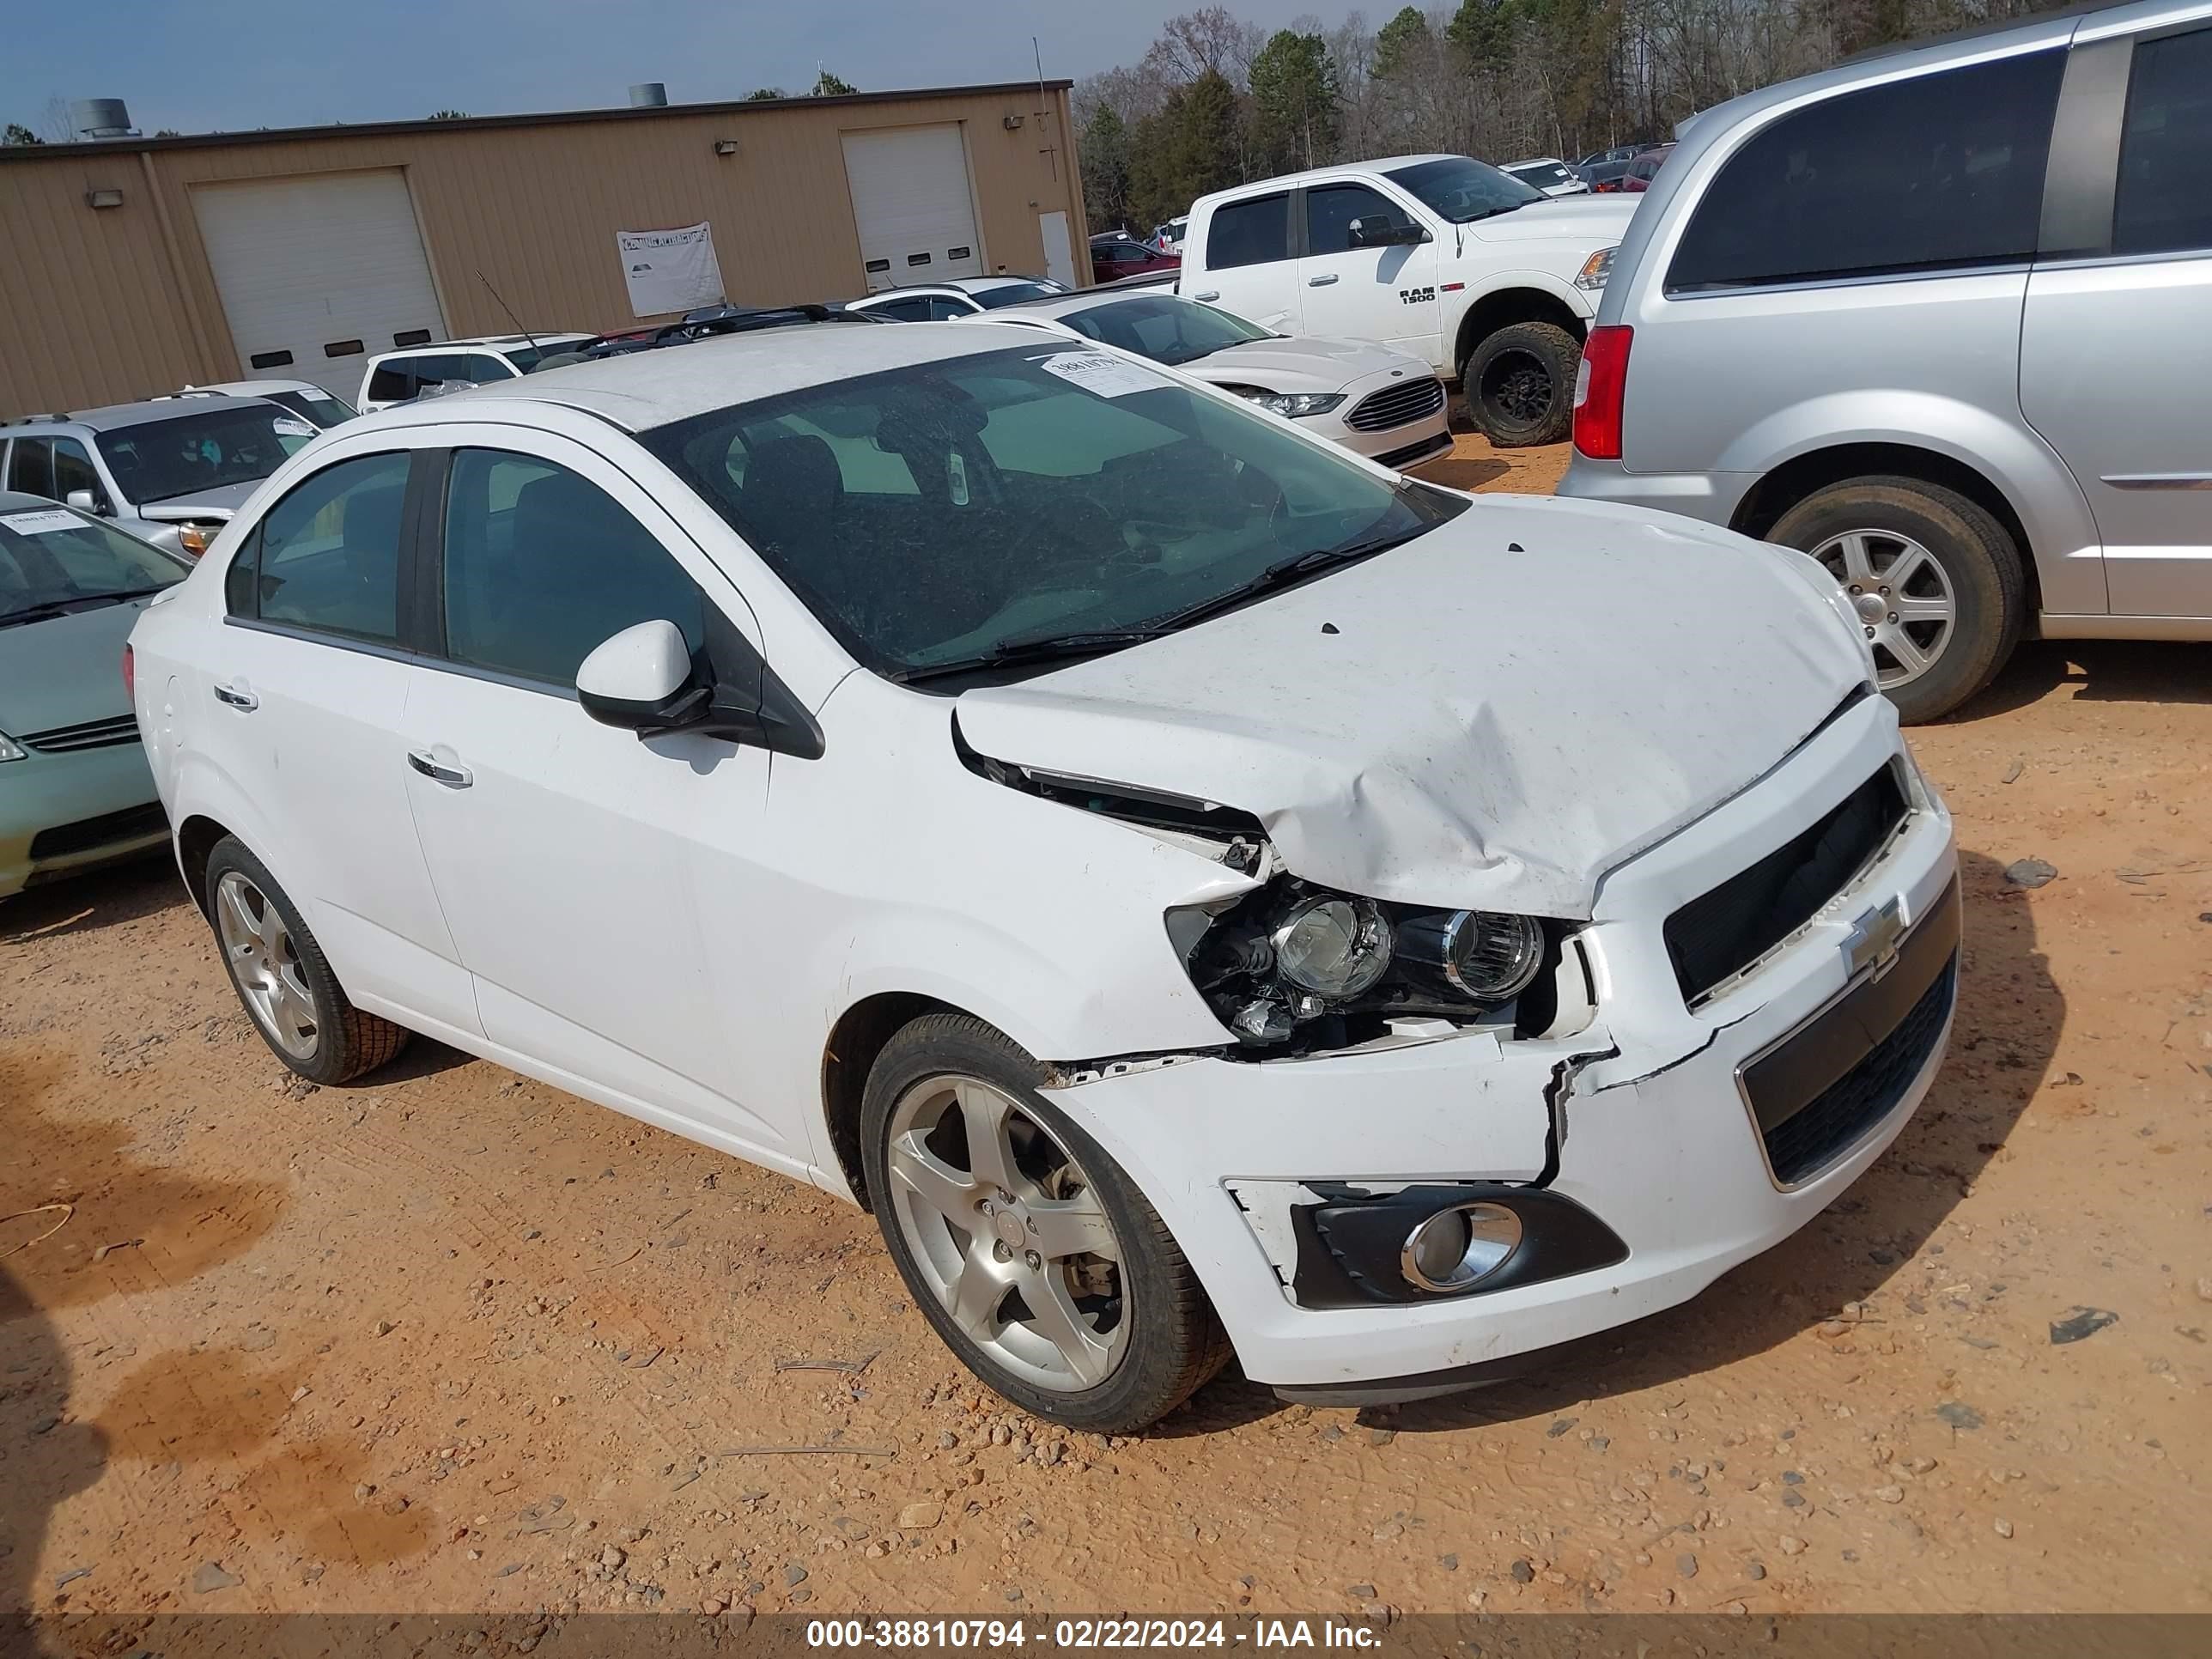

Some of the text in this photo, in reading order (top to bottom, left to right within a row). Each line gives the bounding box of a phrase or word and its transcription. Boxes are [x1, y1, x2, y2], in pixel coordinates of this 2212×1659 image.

[623, 230, 708, 250] COMING ATTRACTIONS
[1400, 287, 1435, 298] RAM
[1402, 294, 1435, 305] 1500
